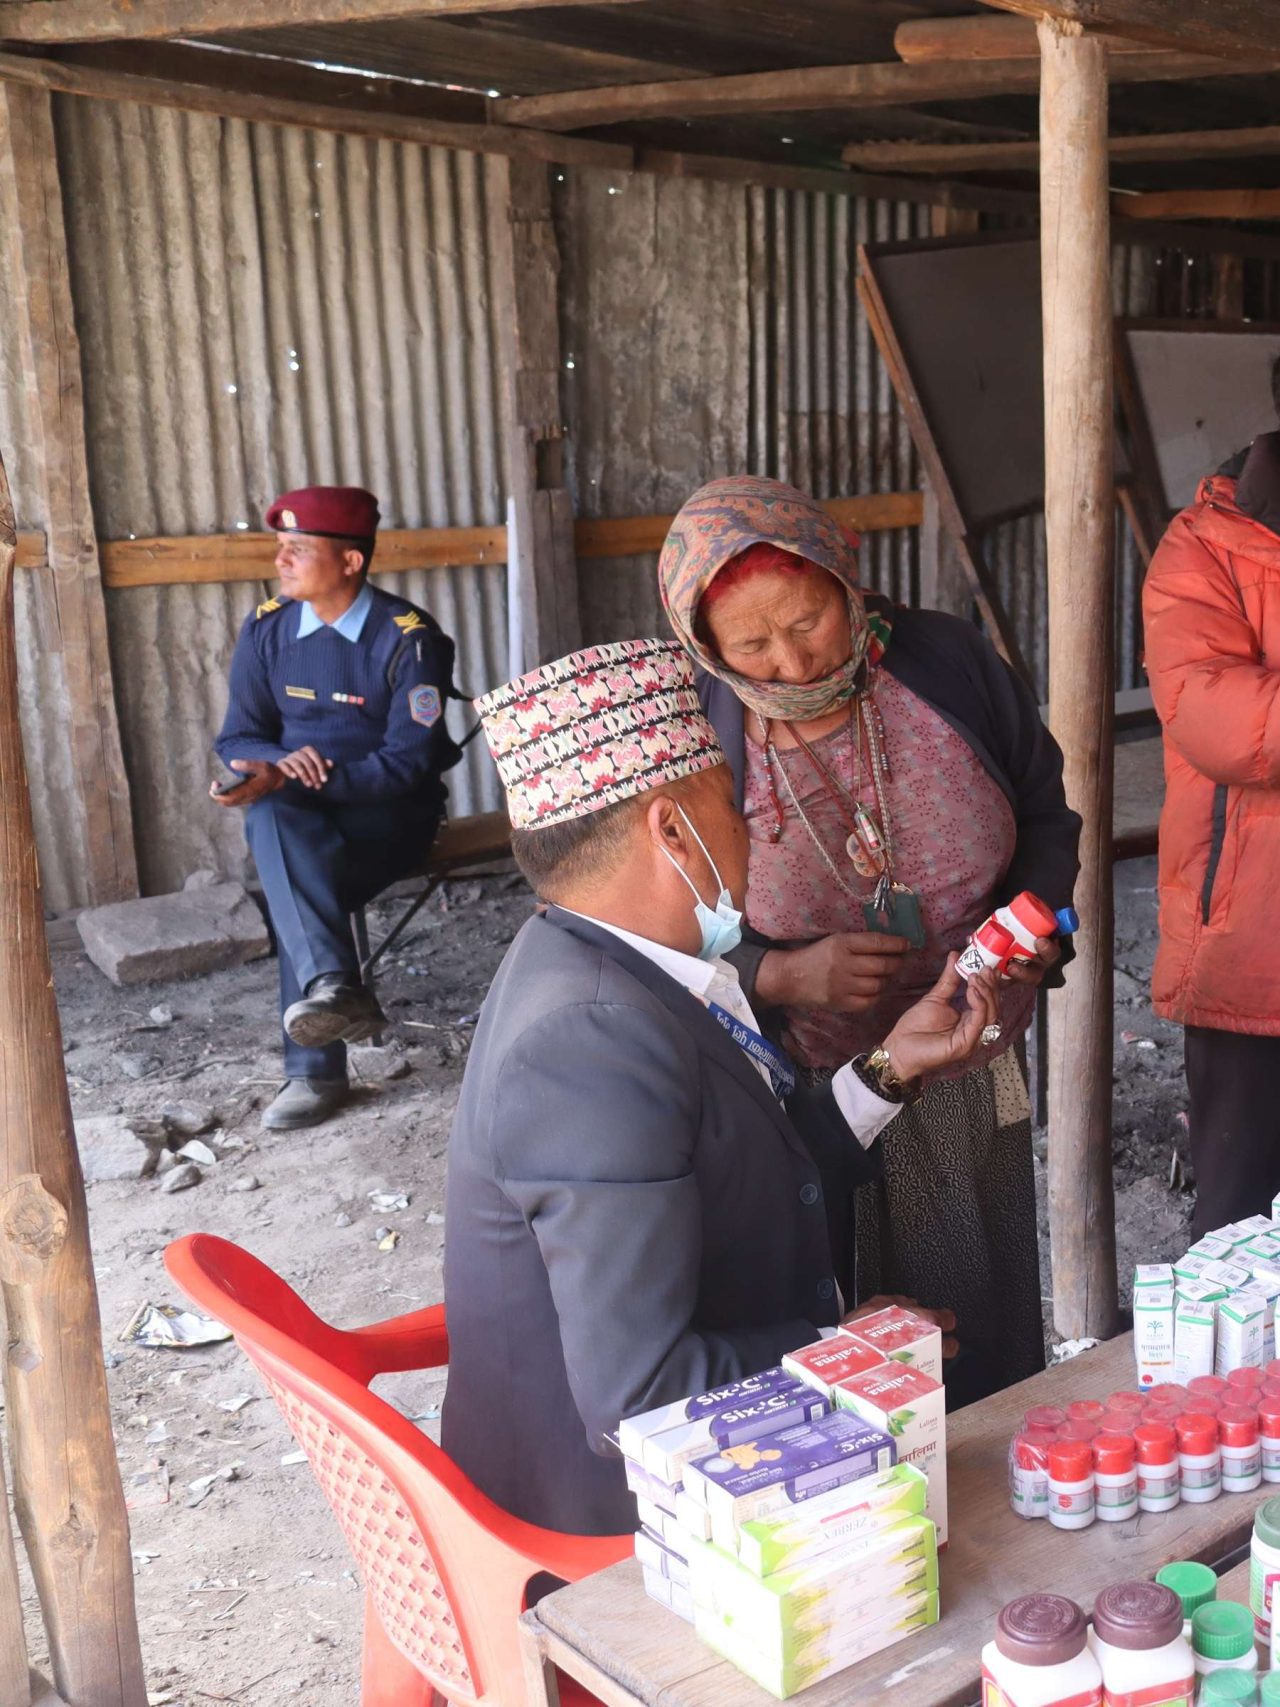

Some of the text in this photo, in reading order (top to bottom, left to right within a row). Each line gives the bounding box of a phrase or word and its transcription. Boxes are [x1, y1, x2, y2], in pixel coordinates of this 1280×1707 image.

[869, 1319, 915, 1338] Lalima
[814, 1345, 863, 1367] Lalima
[867, 1373, 916, 1396] Lalima
